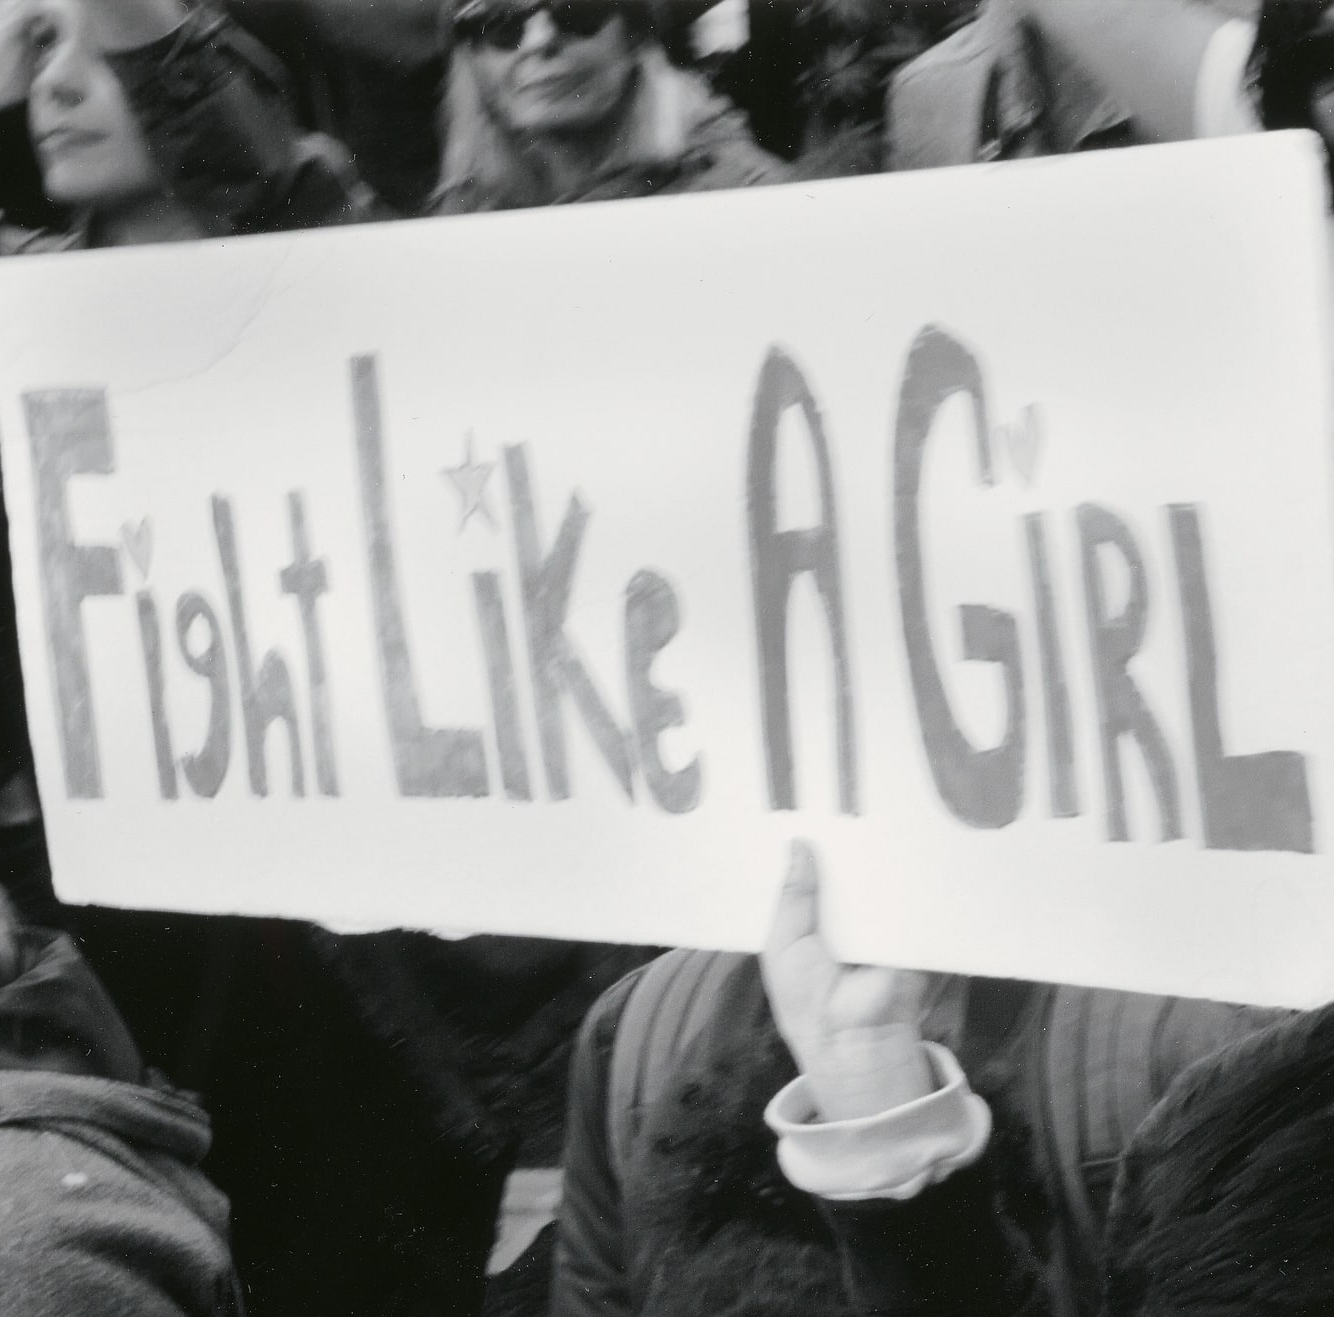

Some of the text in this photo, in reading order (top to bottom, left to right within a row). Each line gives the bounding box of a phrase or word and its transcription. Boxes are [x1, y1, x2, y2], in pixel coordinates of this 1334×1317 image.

[20, 386, 342, 803] Fight
[347, 352, 704, 816] Like
[742, 344, 861, 817] A
